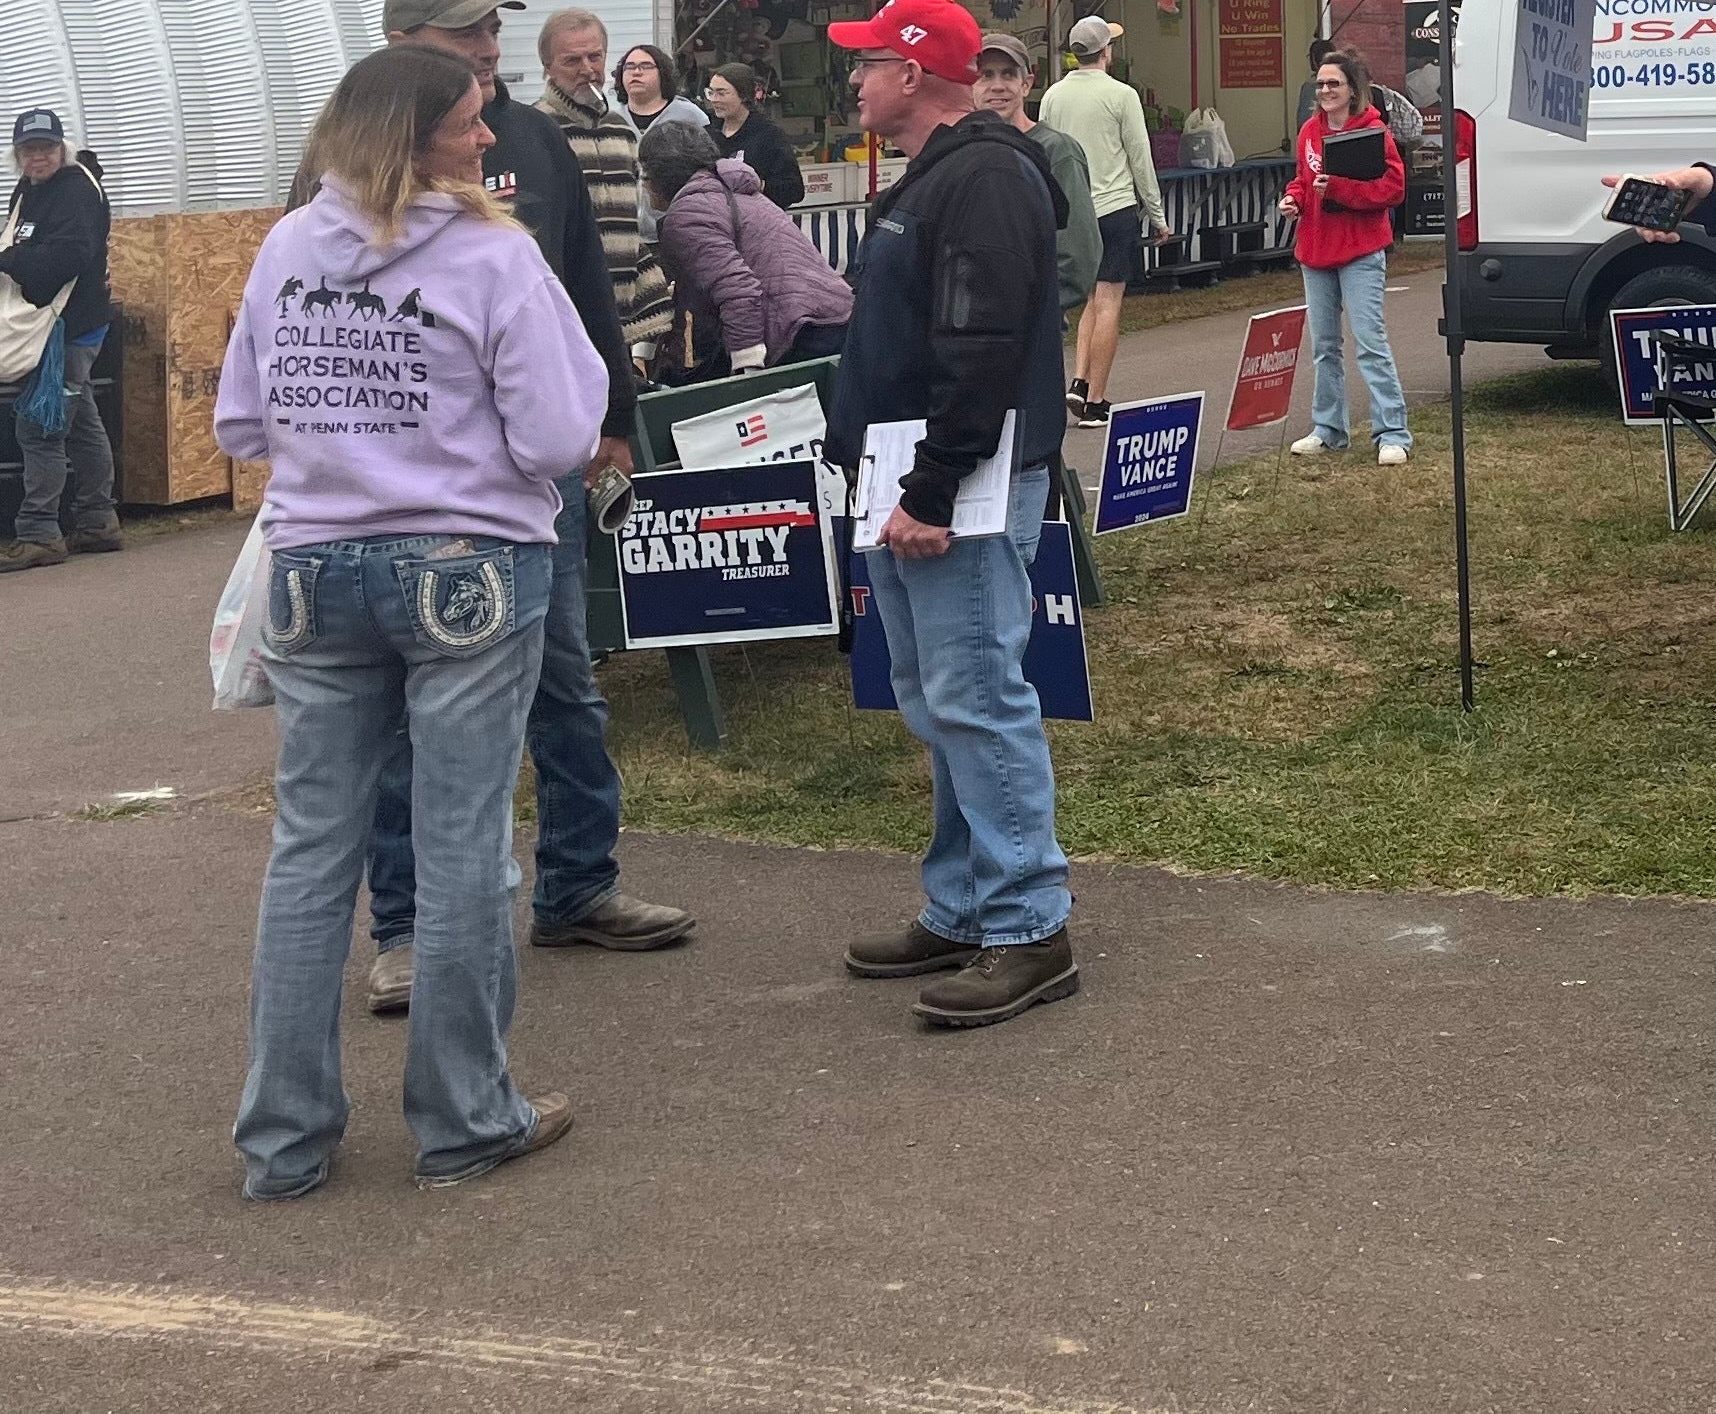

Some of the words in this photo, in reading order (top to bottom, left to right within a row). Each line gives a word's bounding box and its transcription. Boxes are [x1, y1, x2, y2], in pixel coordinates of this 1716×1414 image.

[1221, 24, 1238, 34] No
[1242, 24, 1280, 34] Trades
[1231, 11, 1240, 21] U
[1244, 10, 1268, 20] Win
[900, 24, 928, 46] 47
[1532, 22, 1549, 63] TO
[1550, 28, 1584, 75] Vote
[1541, 70, 1585, 127] HERE
[274, 326, 422, 354] COLLEGIATE
[268, 356, 428, 384] HORSEMAN'S
[1241, 356, 1262, 378] DAVE
[268, 386, 429, 412] ASSOCIATION
[295, 422, 308, 434] AT
[311, 422, 348, 434] PENN
[353, 422, 398, 434] STATE
[1116, 426, 1189, 465] TRUMP
[1120, 455, 1178, 487] VANCE
[622, 507, 703, 538] STACY
[622, 525, 791, 575] GARRITY
[722, 564, 790, 581] TREASURER
